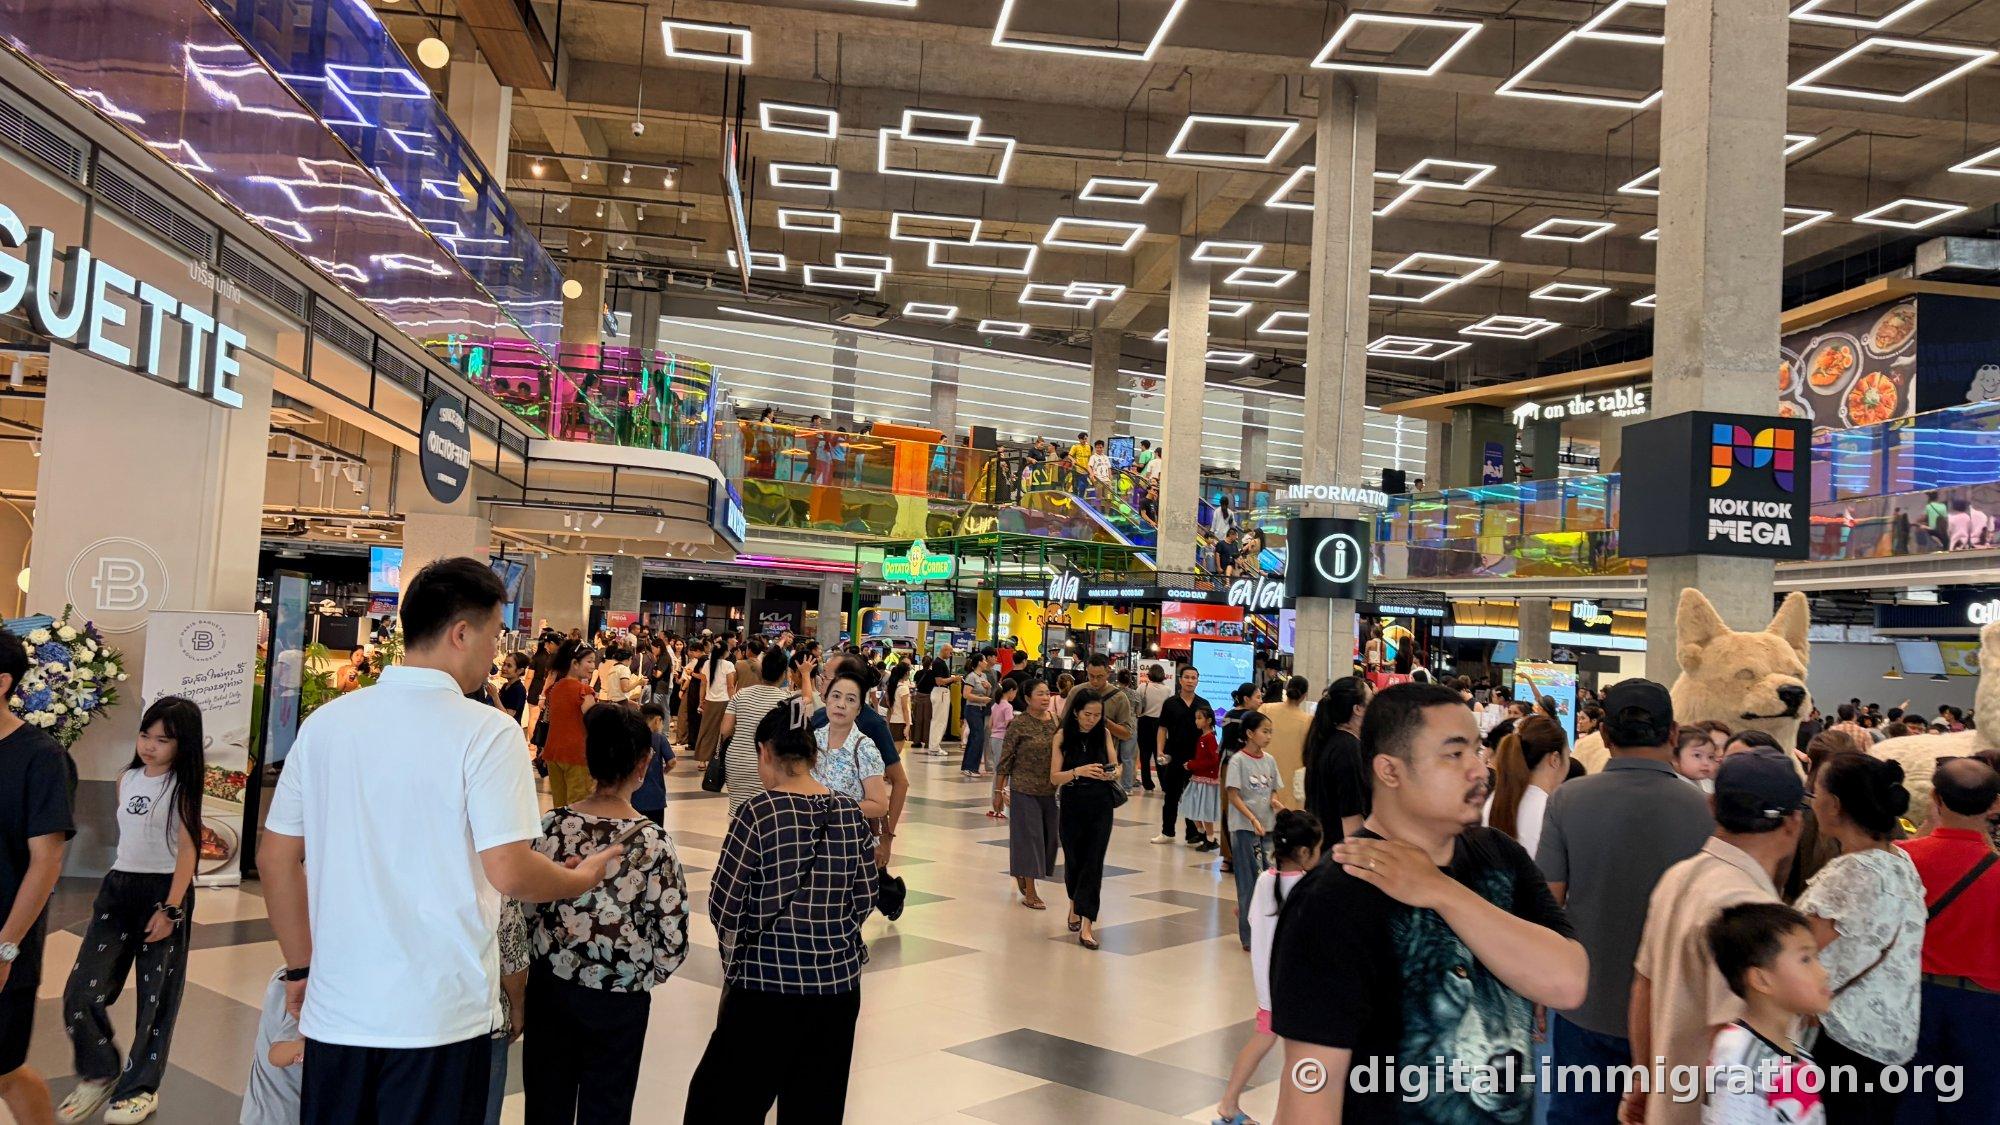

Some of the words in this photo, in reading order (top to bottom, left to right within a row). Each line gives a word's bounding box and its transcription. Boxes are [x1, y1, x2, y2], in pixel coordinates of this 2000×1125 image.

[1544, 405, 1564, 419] on
[1568, 394, 1595, 415] the
[1598, 387, 1645, 412] table
[1708, 497, 1750, 517] KOK
[1752, 501, 1792, 520] KOK
[1708, 518, 1792, 546] MEGA
[884, 562, 909, 574] POTATO
[922, 560, 949, 575] CORNER
[1168, 590, 1191, 598] GOOD
[1192, 591, 1207, 600] DAY
[181, 622, 197, 636] PARIS
[198, 619, 226, 637] BAGUETTE
